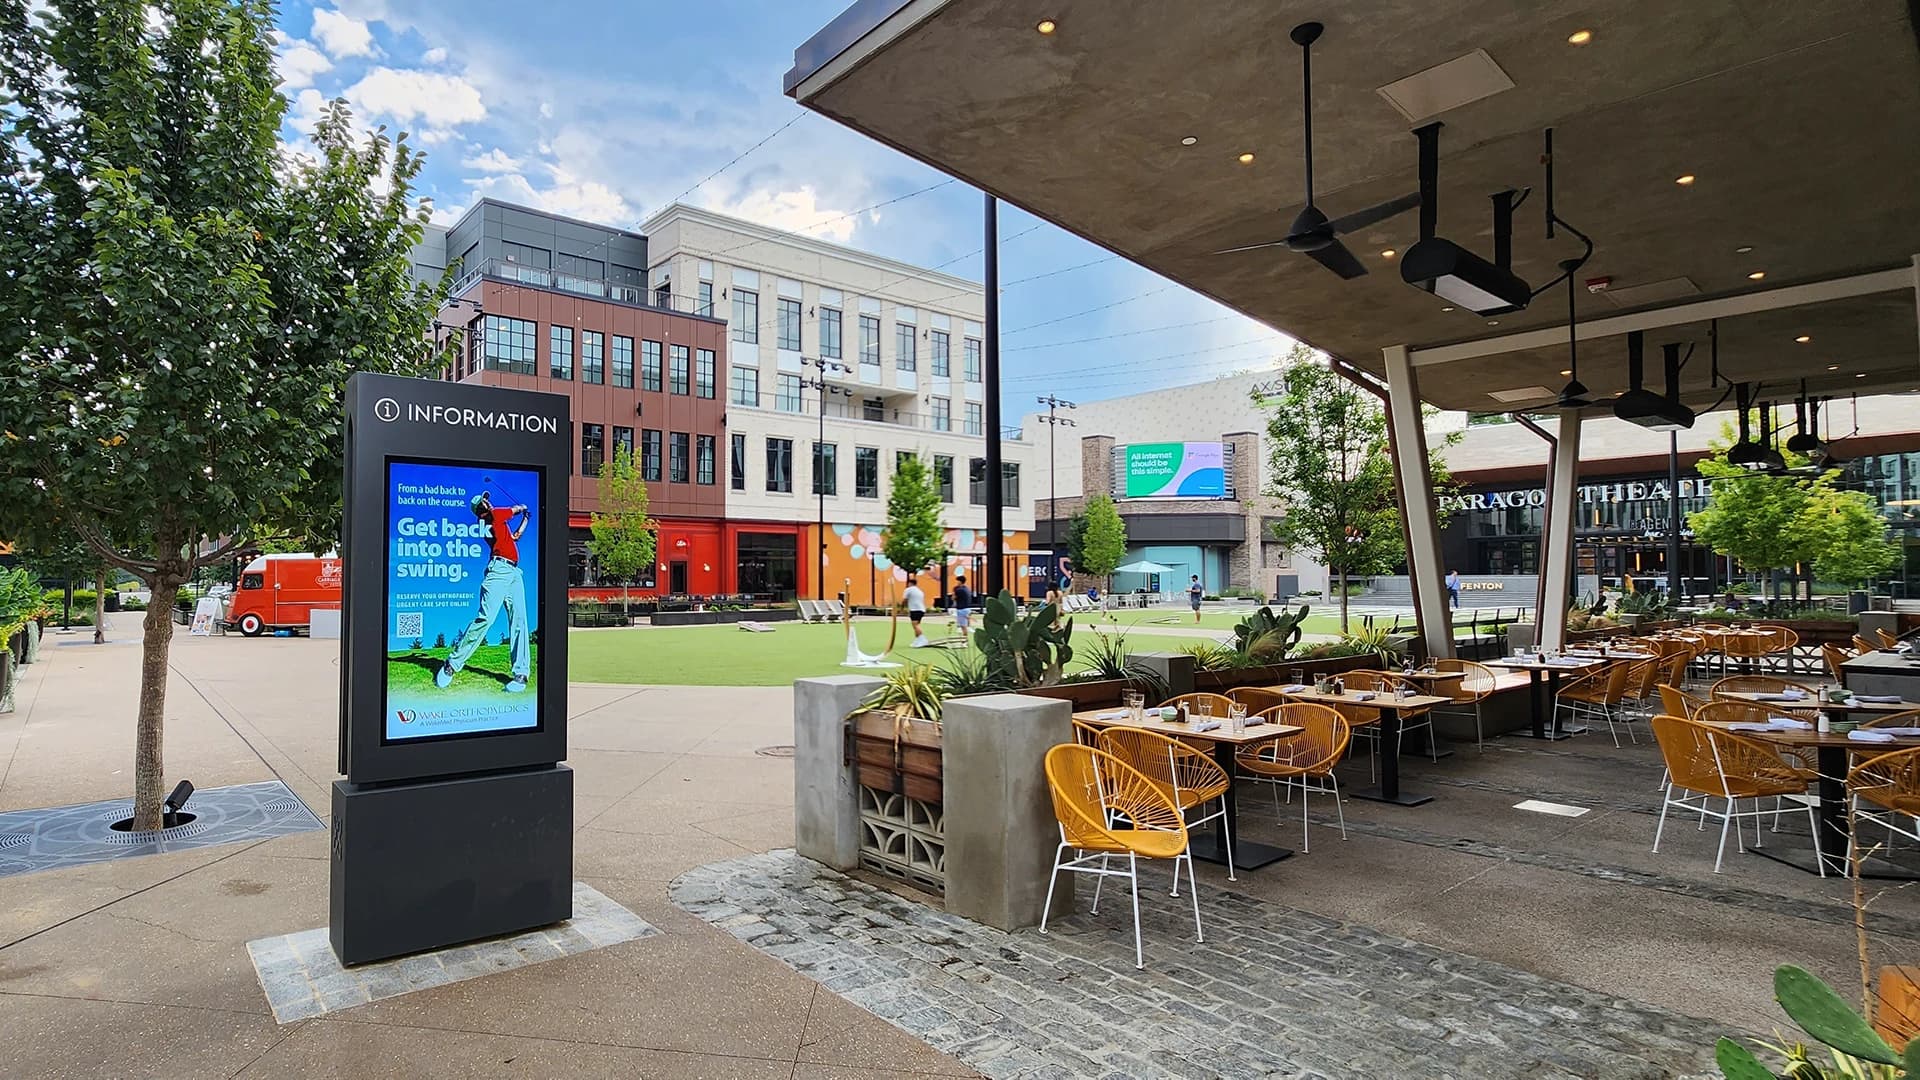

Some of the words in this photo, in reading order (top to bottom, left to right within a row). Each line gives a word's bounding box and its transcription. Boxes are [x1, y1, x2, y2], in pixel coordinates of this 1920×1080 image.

[408, 403, 557, 434] INFORMATION
[1131, 452, 1140, 460] All
[1141, 452, 1172, 460] internet
[1146, 467, 1173, 475] simple.
[398, 483, 417, 494] From
[418, 486, 424, 494] a
[424, 484, 438, 495] bad
[440, 485, 457, 496] back
[458, 487, 466, 496] to
[1437, 488, 1546, 511] PARAGO
[1577, 478, 1713, 502] THEATE
[398, 495, 416, 505] back
[416, 498, 426, 506] on
[428, 496, 440, 506] the
[441, 498, 466, 507] course.
[397, 517, 437, 537] Get
[442, 517, 493, 538] back
[1640, 518, 1684, 530] AGENY
[397, 537, 442, 557] into
[446, 538, 482, 558] the
[397, 558, 469, 583] swing.
[1460, 582, 1503, 590] FENTON
[419, 710, 445, 720] WAKE
